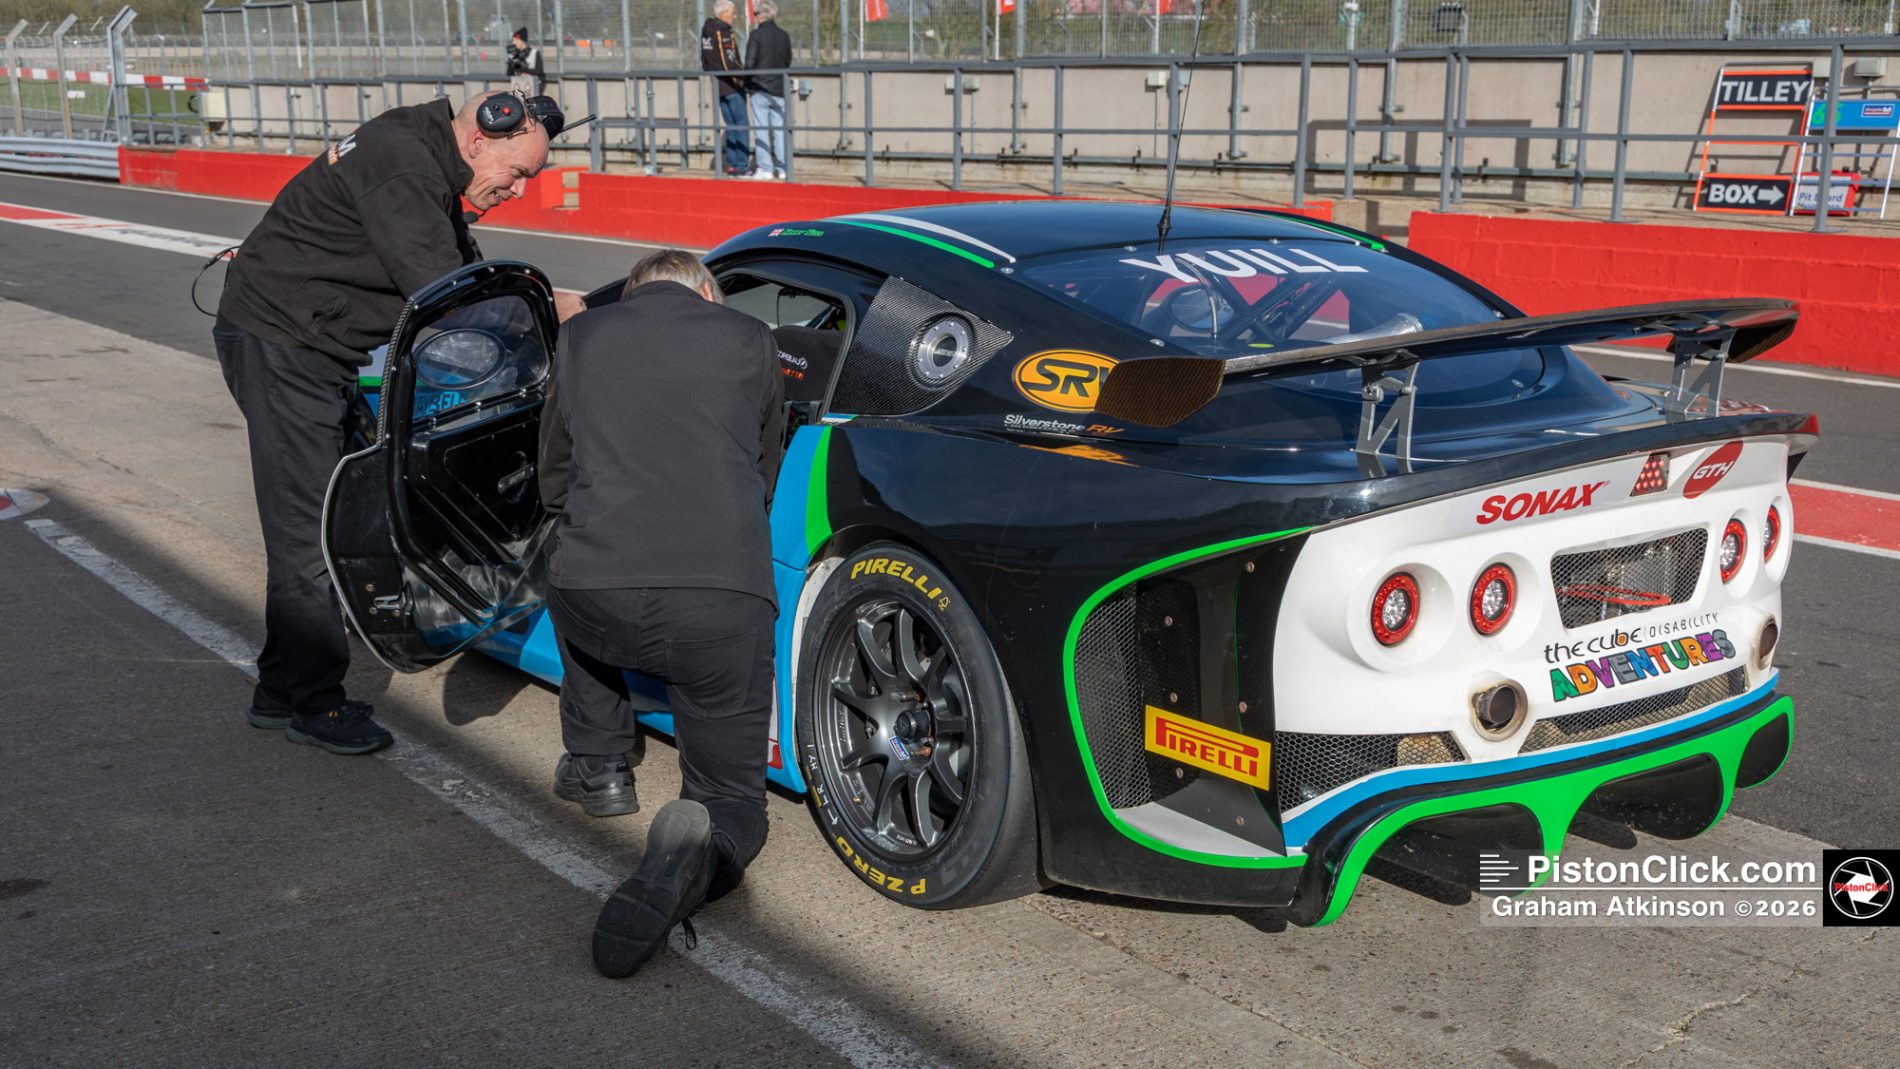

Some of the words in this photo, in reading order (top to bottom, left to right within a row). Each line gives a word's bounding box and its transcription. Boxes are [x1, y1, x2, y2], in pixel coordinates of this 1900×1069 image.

[1721, 81, 1809, 102] TILLEY
[1708, 184, 1758, 204] BOX
[1798, 192, 1812, 201] Pit
[1814, 192, 1843, 201] ard
[1118, 248, 1369, 283] YUILL
[1003, 414, 1086, 431] Silverstone
[1086, 424, 1126, 435] RV
[1692, 461, 1735, 480] GTH
[1476, 481, 1606, 525] SONAX
[851, 558, 940, 600] PIRELLI
[1649, 612, 1719, 638] DISABILITY
[1549, 629, 1737, 702] ADVENTURES
[1155, 716, 1260, 778] PIRELLI
[836, 836, 904, 893] ZERO
